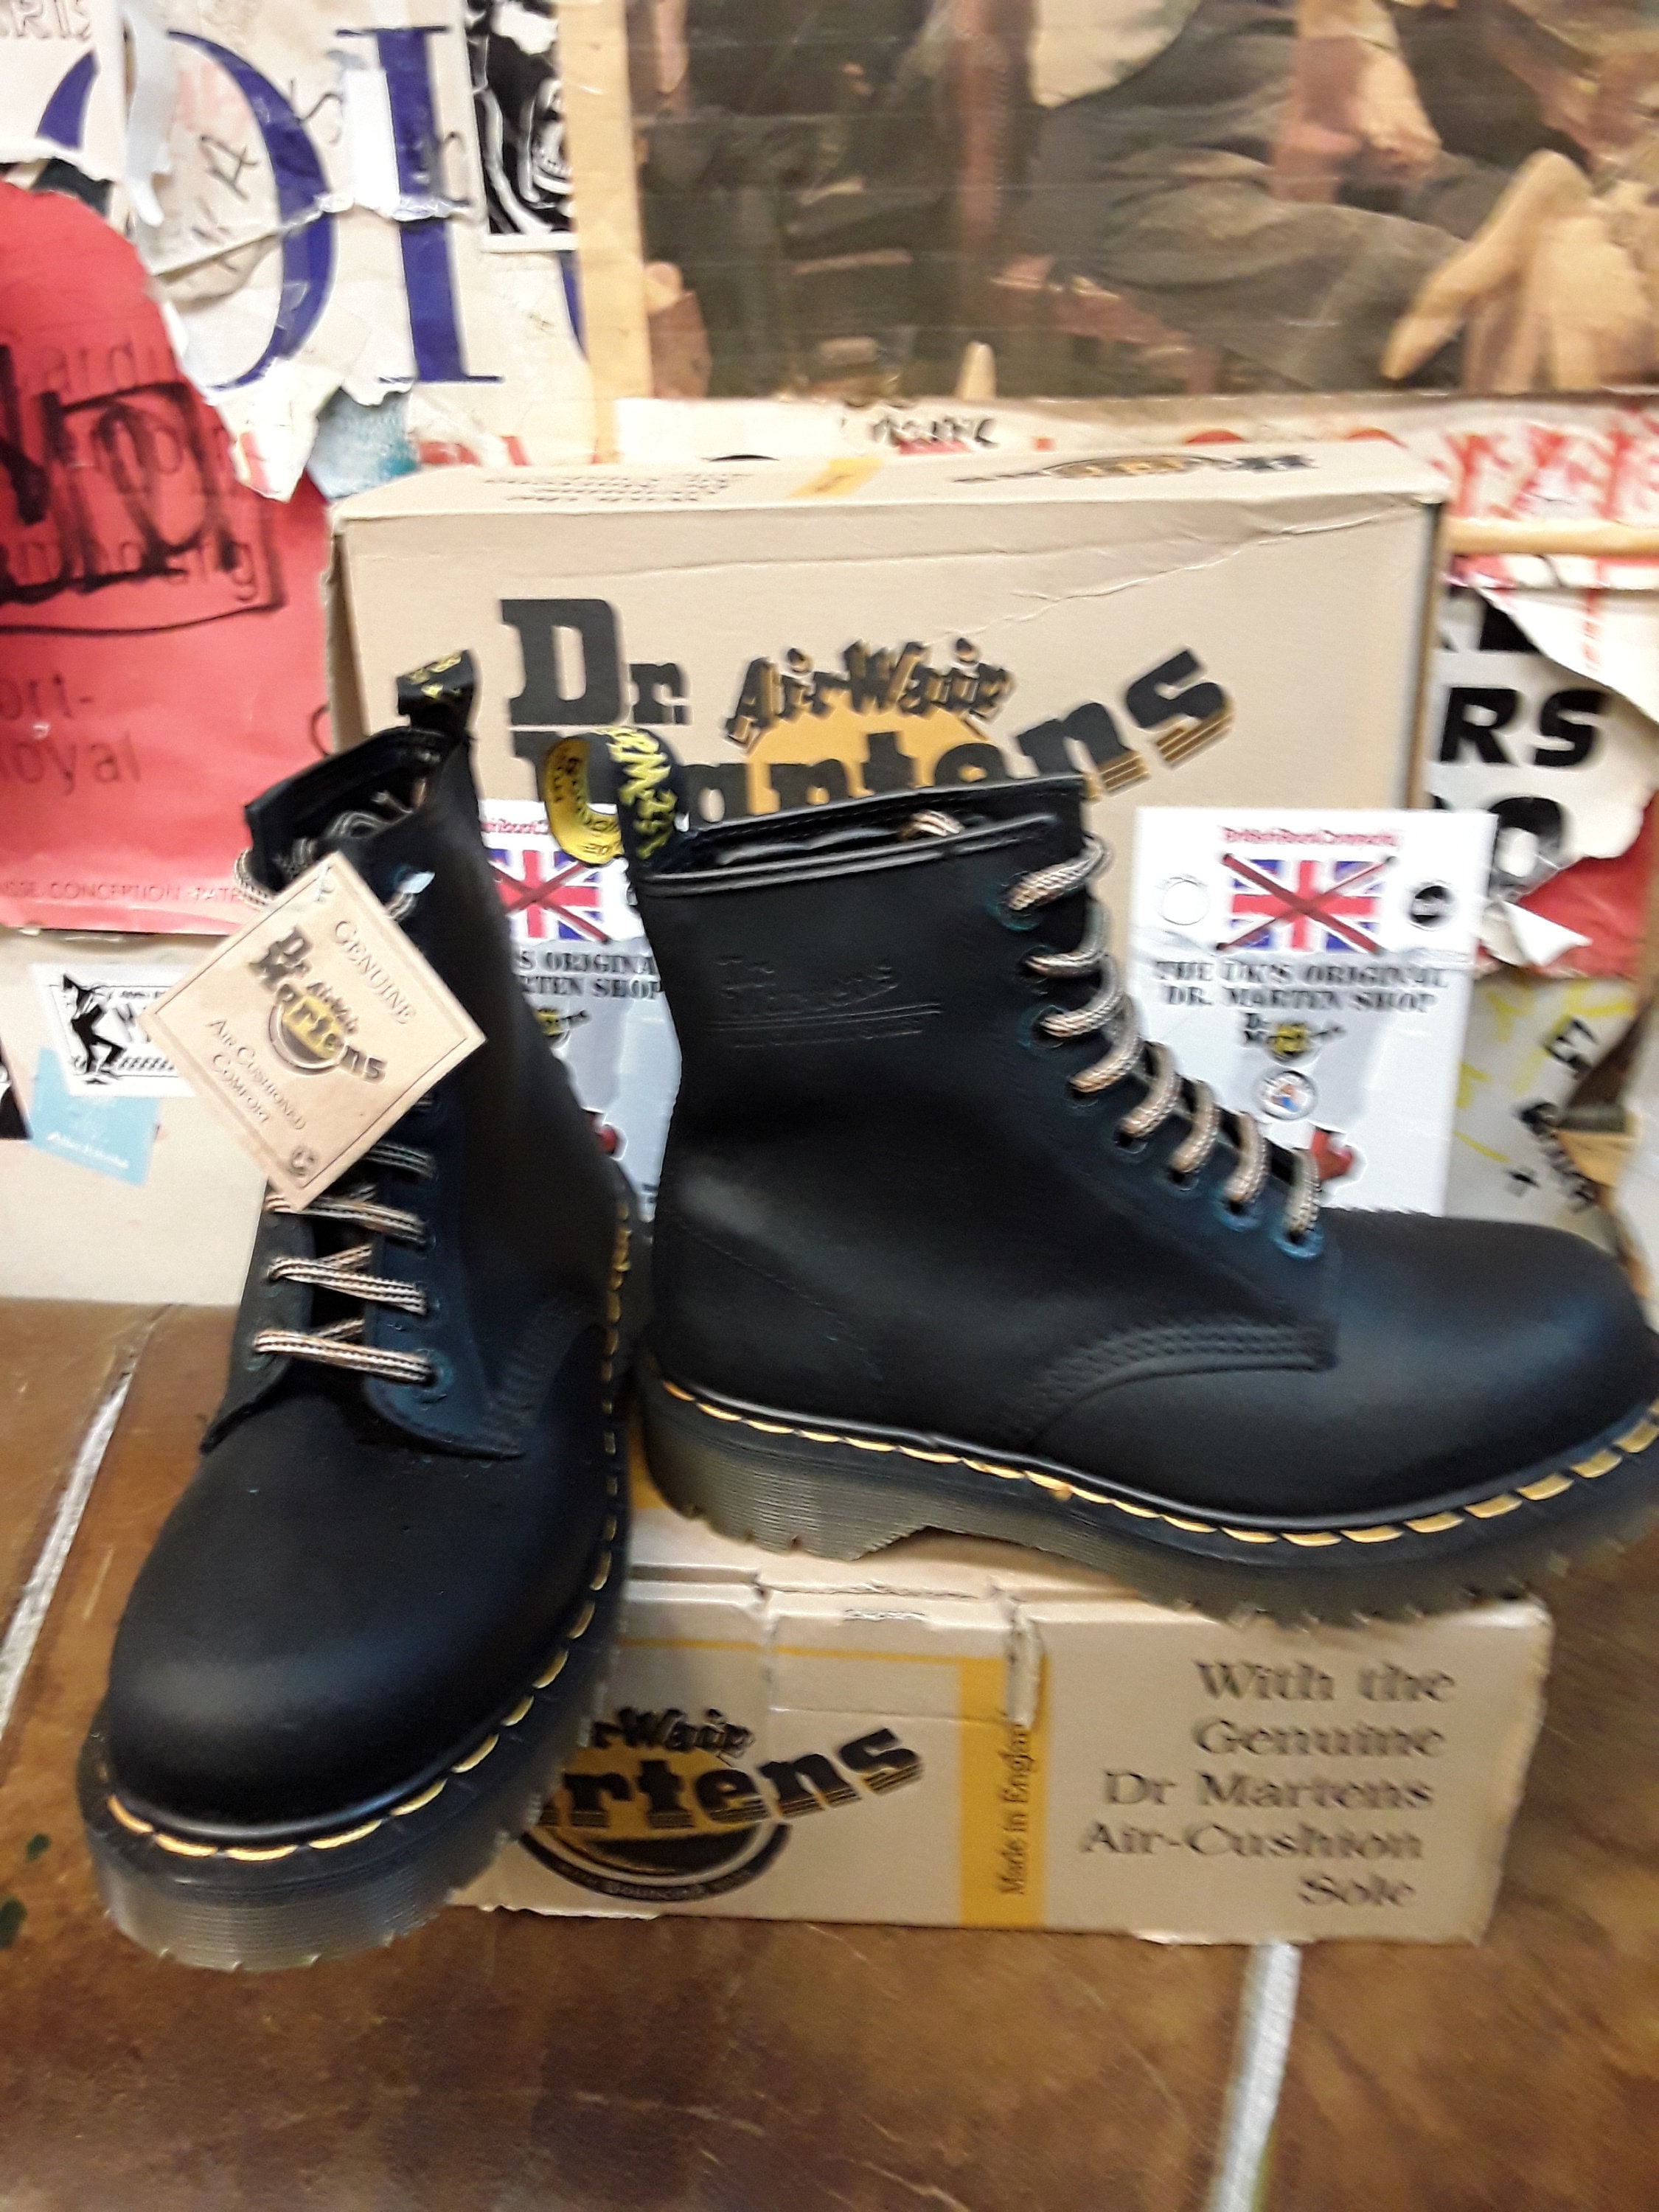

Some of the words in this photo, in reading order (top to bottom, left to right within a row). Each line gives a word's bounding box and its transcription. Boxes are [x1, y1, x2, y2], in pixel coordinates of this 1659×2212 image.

[726, 637, 1016, 745] AirWair
[0, 728, 141, 796] oyal
[334, 920, 417, 1026] GENUINE
[546, 953, 656, 975] ORIGINA
[1306, 965, 1447, 988] ORIGINAL
[248, 946, 388, 1079] Martens
[1222, 987, 1340, 1009] MARTEN
[1354, 991, 1438, 1013] SHOP
[1195, 1660, 1336, 1701] With
[1360, 1663, 1455, 1703] the
[594, 1708, 755, 1758] rWair
[1192, 1717, 1447, 1758] Genuine
[998, 1723, 1035, 1804] Englan
[1106, 1770, 1176, 1806] Dr
[1199, 1772, 1435, 1810] Martens
[1001, 1812, 1029, 1834] in
[1080, 1821, 1423, 1860] Air-Cushion
[997, 1841, 1026, 1895] Made
[1298, 1872, 1416, 1907] Sole
